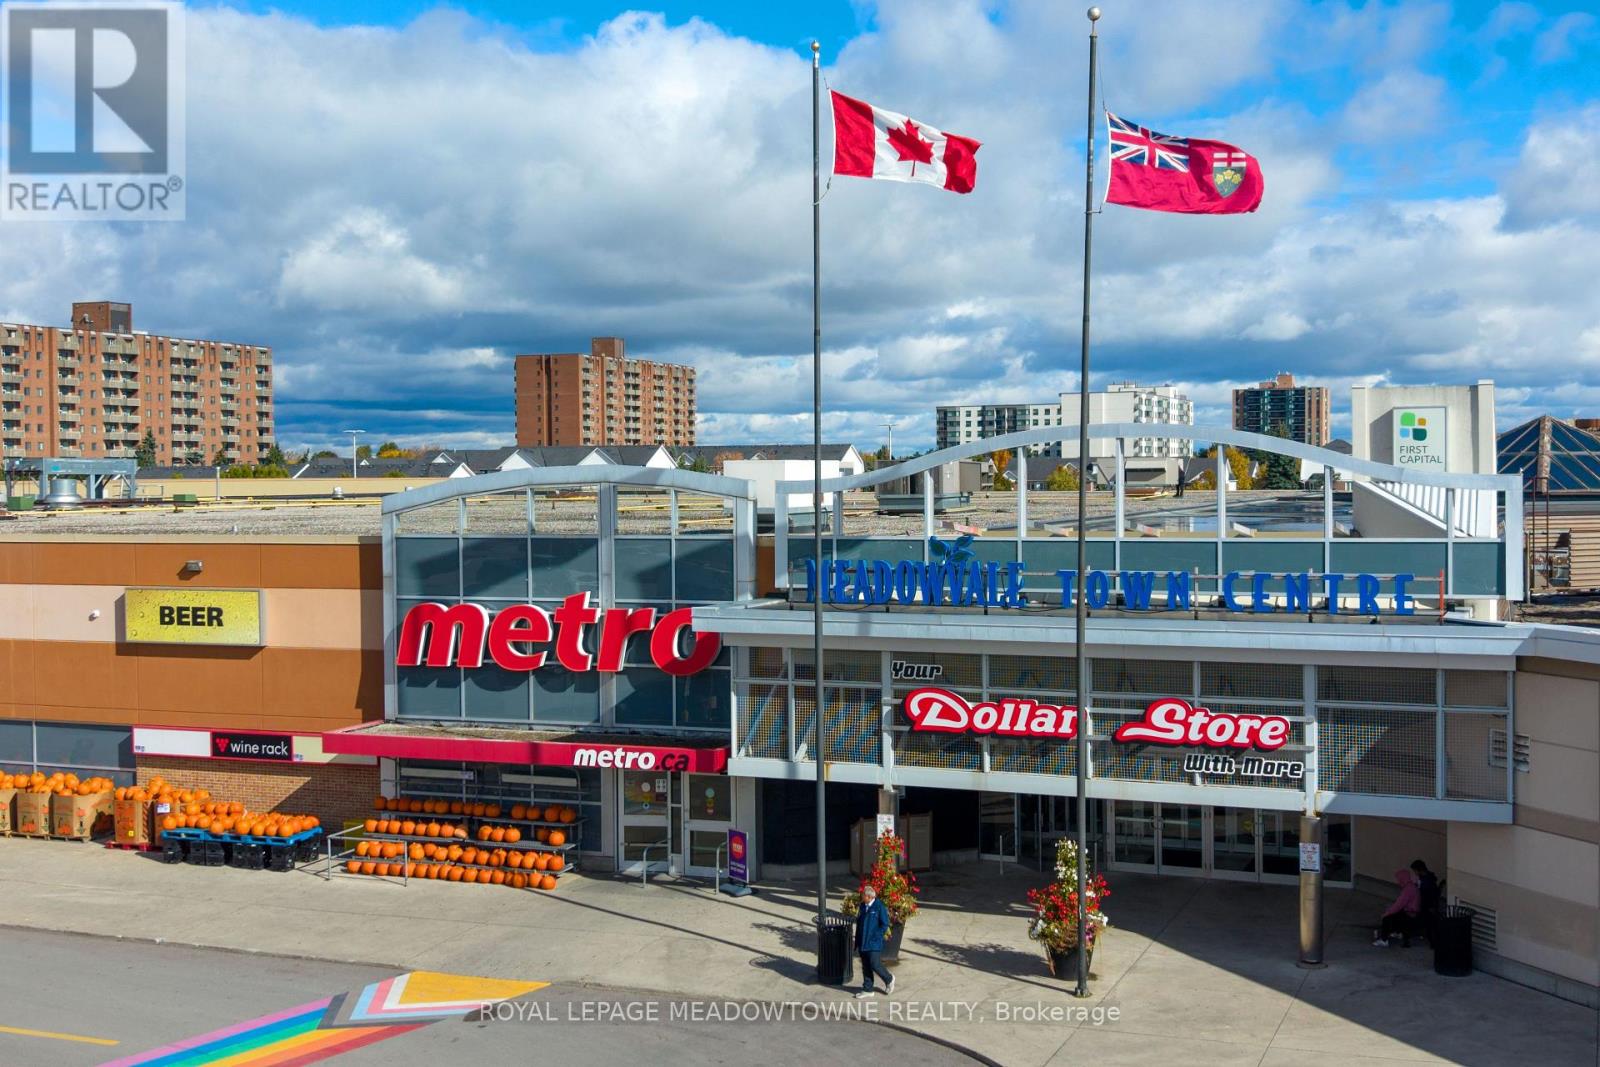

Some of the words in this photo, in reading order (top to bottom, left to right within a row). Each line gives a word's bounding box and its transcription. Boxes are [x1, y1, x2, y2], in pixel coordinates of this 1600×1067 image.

[1399, 445, 1428, 454] FIRST
[1399, 455, 1443, 464] CAPITAL
[806, 559, 1026, 607] MEADOWVALE
[1056, 569, 1190, 611] TOWN
[1223, 572, 1415, 616] CENTRE
[159, 605, 224, 627] BEER
[396, 591, 722, 676] metro
[891, 660, 942, 680] Your
[906, 689, 1078, 736] Dollar
[1119, 700, 1288, 748] Store
[230, 740, 259, 754] wine
[261, 741, 288, 756] rack
[573, 747, 690, 771] metro.ca
[1184, 754, 1235, 774] With
[1242, 757, 1304, 778] More
